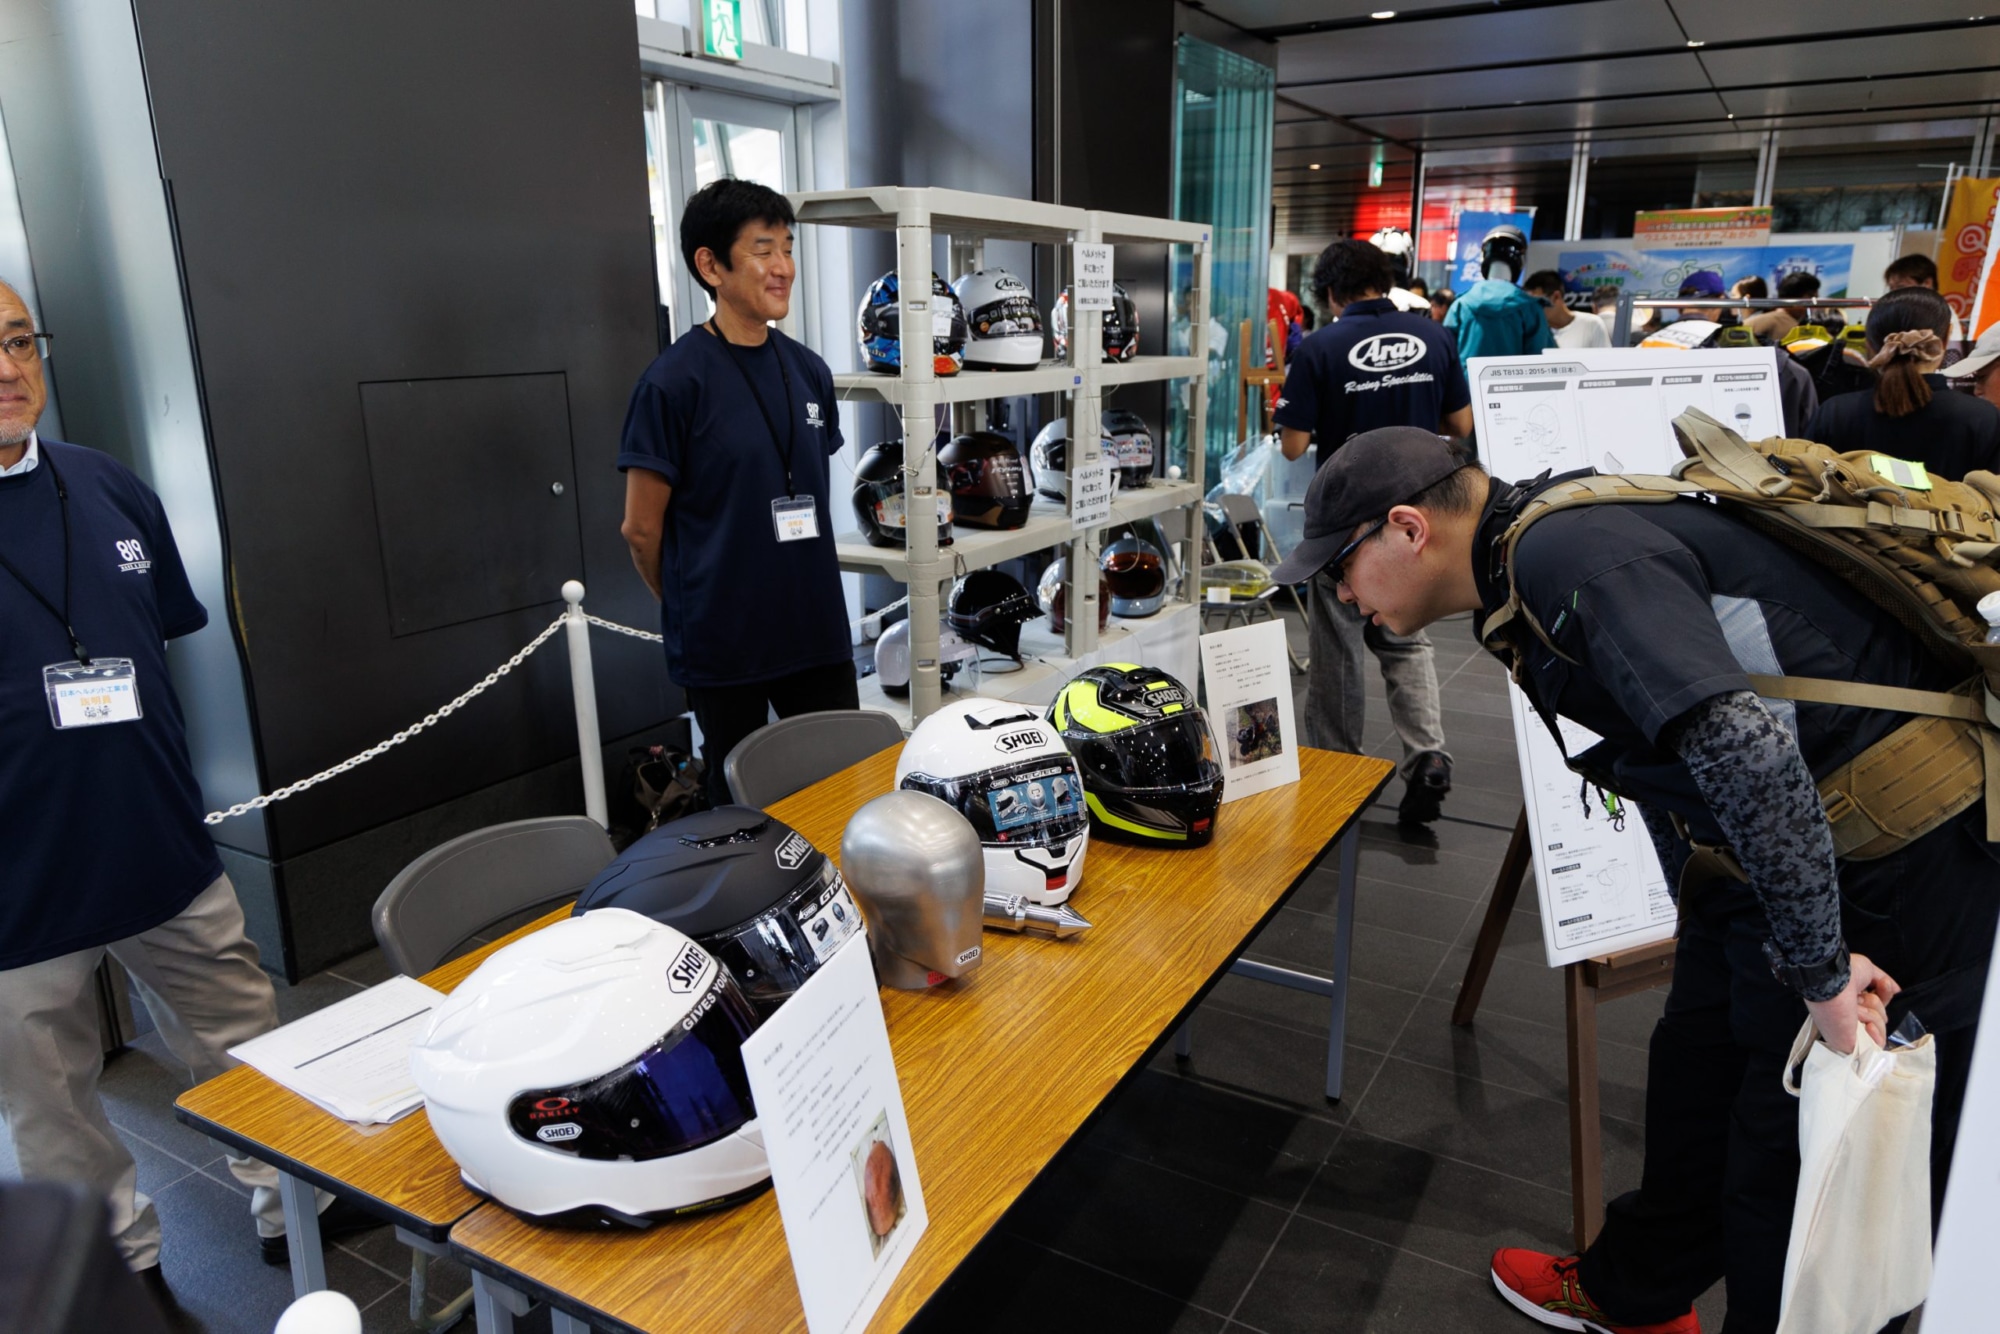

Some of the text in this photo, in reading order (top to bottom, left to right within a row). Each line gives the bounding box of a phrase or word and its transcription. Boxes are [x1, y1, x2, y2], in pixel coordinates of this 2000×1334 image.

[1355, 337, 1420, 366] Arai
[1490, 369, 1502, 377] JIS
[1504, 368, 1524, 376] T8133
[1344, 381, 1380, 394] Racing
[116, 539, 145, 562] 819
[60, 684, 129, 698] 日本ヘルメット工業会
[1147, 689, 1184, 707] SHOEI
[1001, 731, 1043, 751] SHOEI
[960, 949, 979, 963] SHOEI
[671, 942, 708, 988] SHOEI
[682, 972, 728, 1031] GIVES YOU
[529, 1107, 580, 1120] OAKLEY
[544, 1127, 575, 1138] SHOEI
